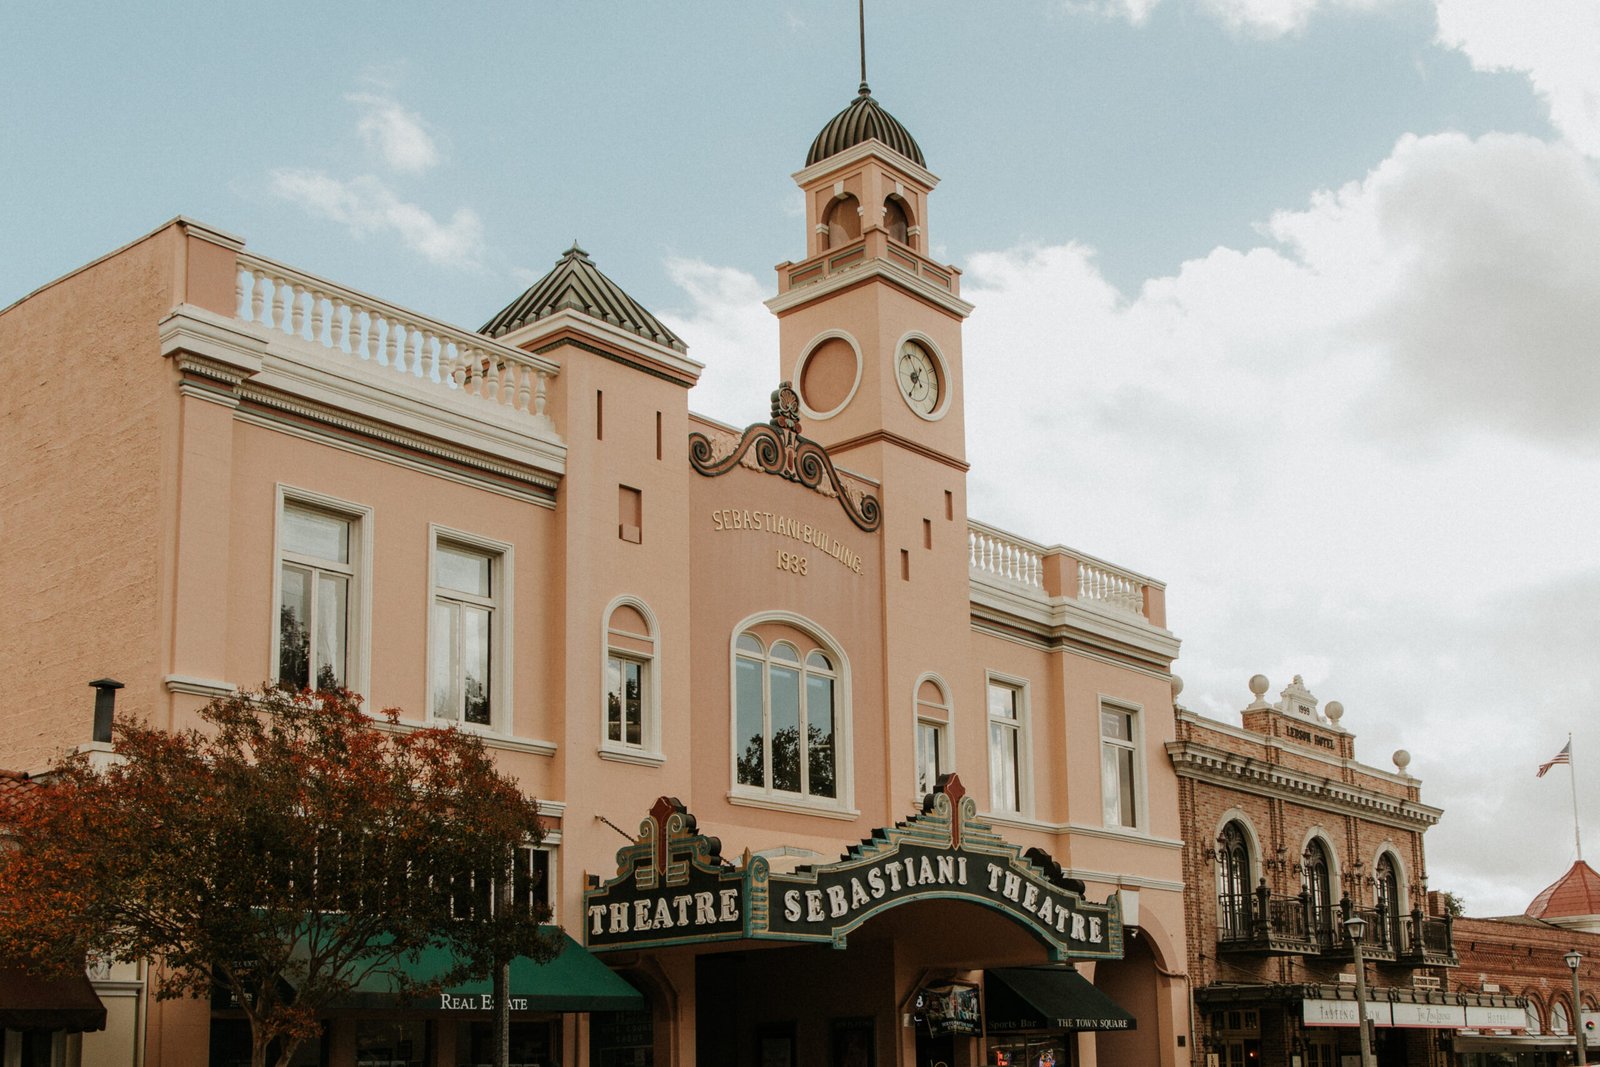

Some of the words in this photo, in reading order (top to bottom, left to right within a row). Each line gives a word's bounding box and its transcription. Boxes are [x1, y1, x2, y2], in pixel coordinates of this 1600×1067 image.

[776, 549, 808, 576] 1933
[588, 888, 740, 936] THEATRE
[784, 855, 968, 922] SEBASTIANI
[986, 862, 1104, 944] THEATRE
[989, 1020, 1017, 1031] Sports
[1020, 1019, 1037, 1028] Bar
[1057, 1018, 1074, 1028] THE
[1076, 1018, 1098, 1029] TOWN
[1100, 1019, 1128, 1029] SQUARE
